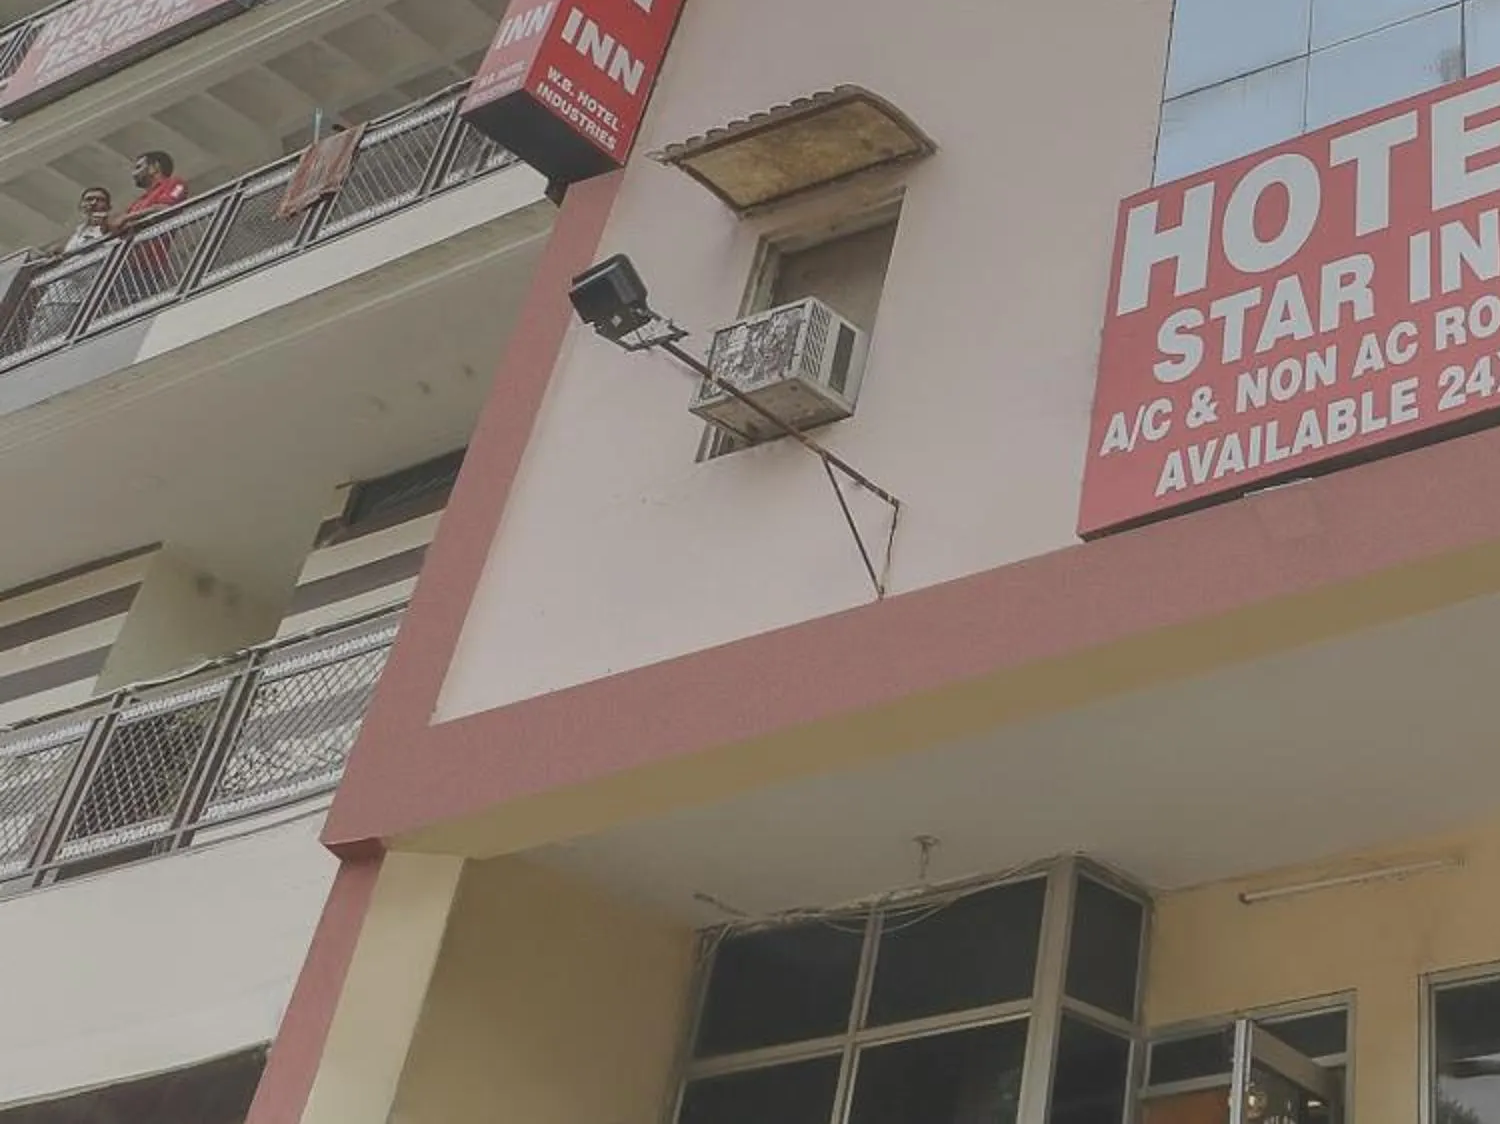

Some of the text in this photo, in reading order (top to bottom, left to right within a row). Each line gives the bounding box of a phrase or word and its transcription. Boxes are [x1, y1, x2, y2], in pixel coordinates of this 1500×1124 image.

[495, 1, 553, 51] INN
[560, 6, 645, 96] INN
[535, 82, 618, 151] INDUSTRIES
[576, 90, 620, 131] HOTEL
[1152, 253, 1376, 383] STAR
[1100, 398, 1173, 457] A/C
[1185, 387, 1219, 429] &
[1235, 346, 1338, 414] NON
[1352, 321, 1419, 377] AC
[1154, 379, 1420, 498] AVAILABLE
